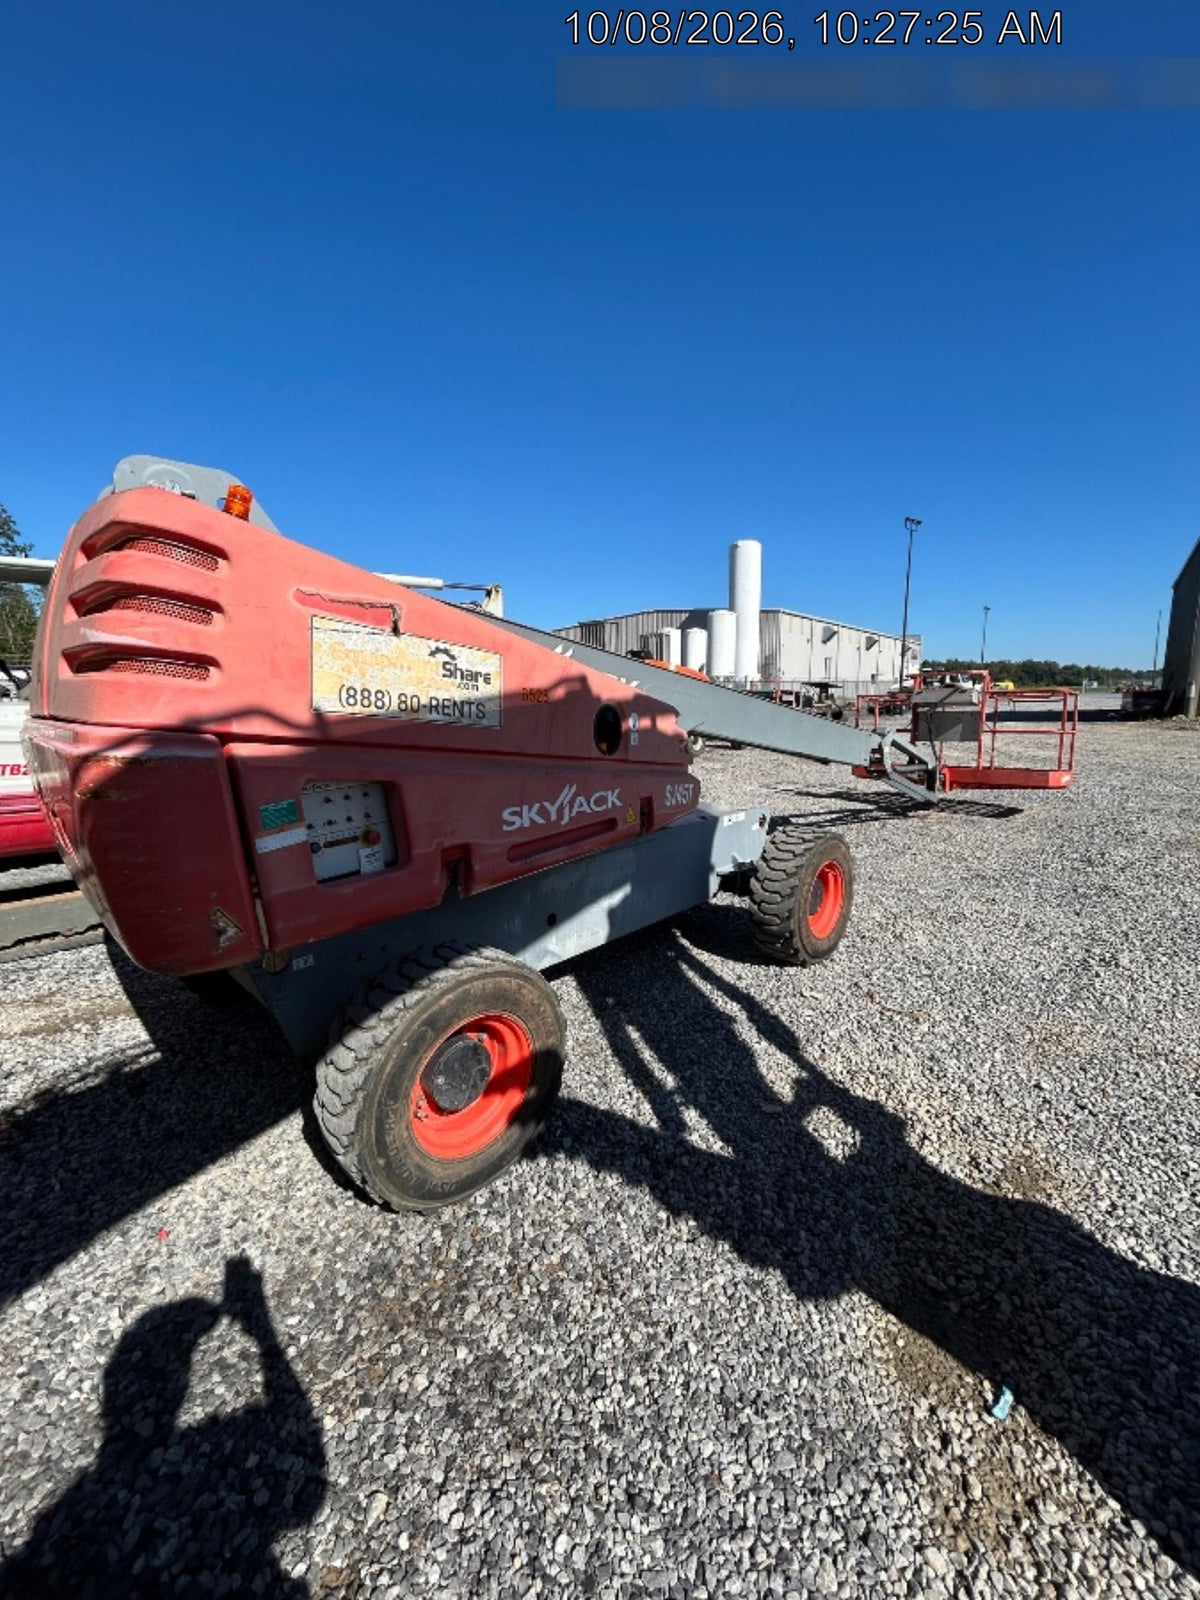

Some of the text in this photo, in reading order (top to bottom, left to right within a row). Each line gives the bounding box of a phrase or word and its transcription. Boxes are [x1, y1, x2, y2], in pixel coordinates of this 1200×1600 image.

[442, 661, 492, 685] Share
[338, 684, 487, 719] (888) 80-RENTS
[501, 783, 623, 831] SKYJACK
